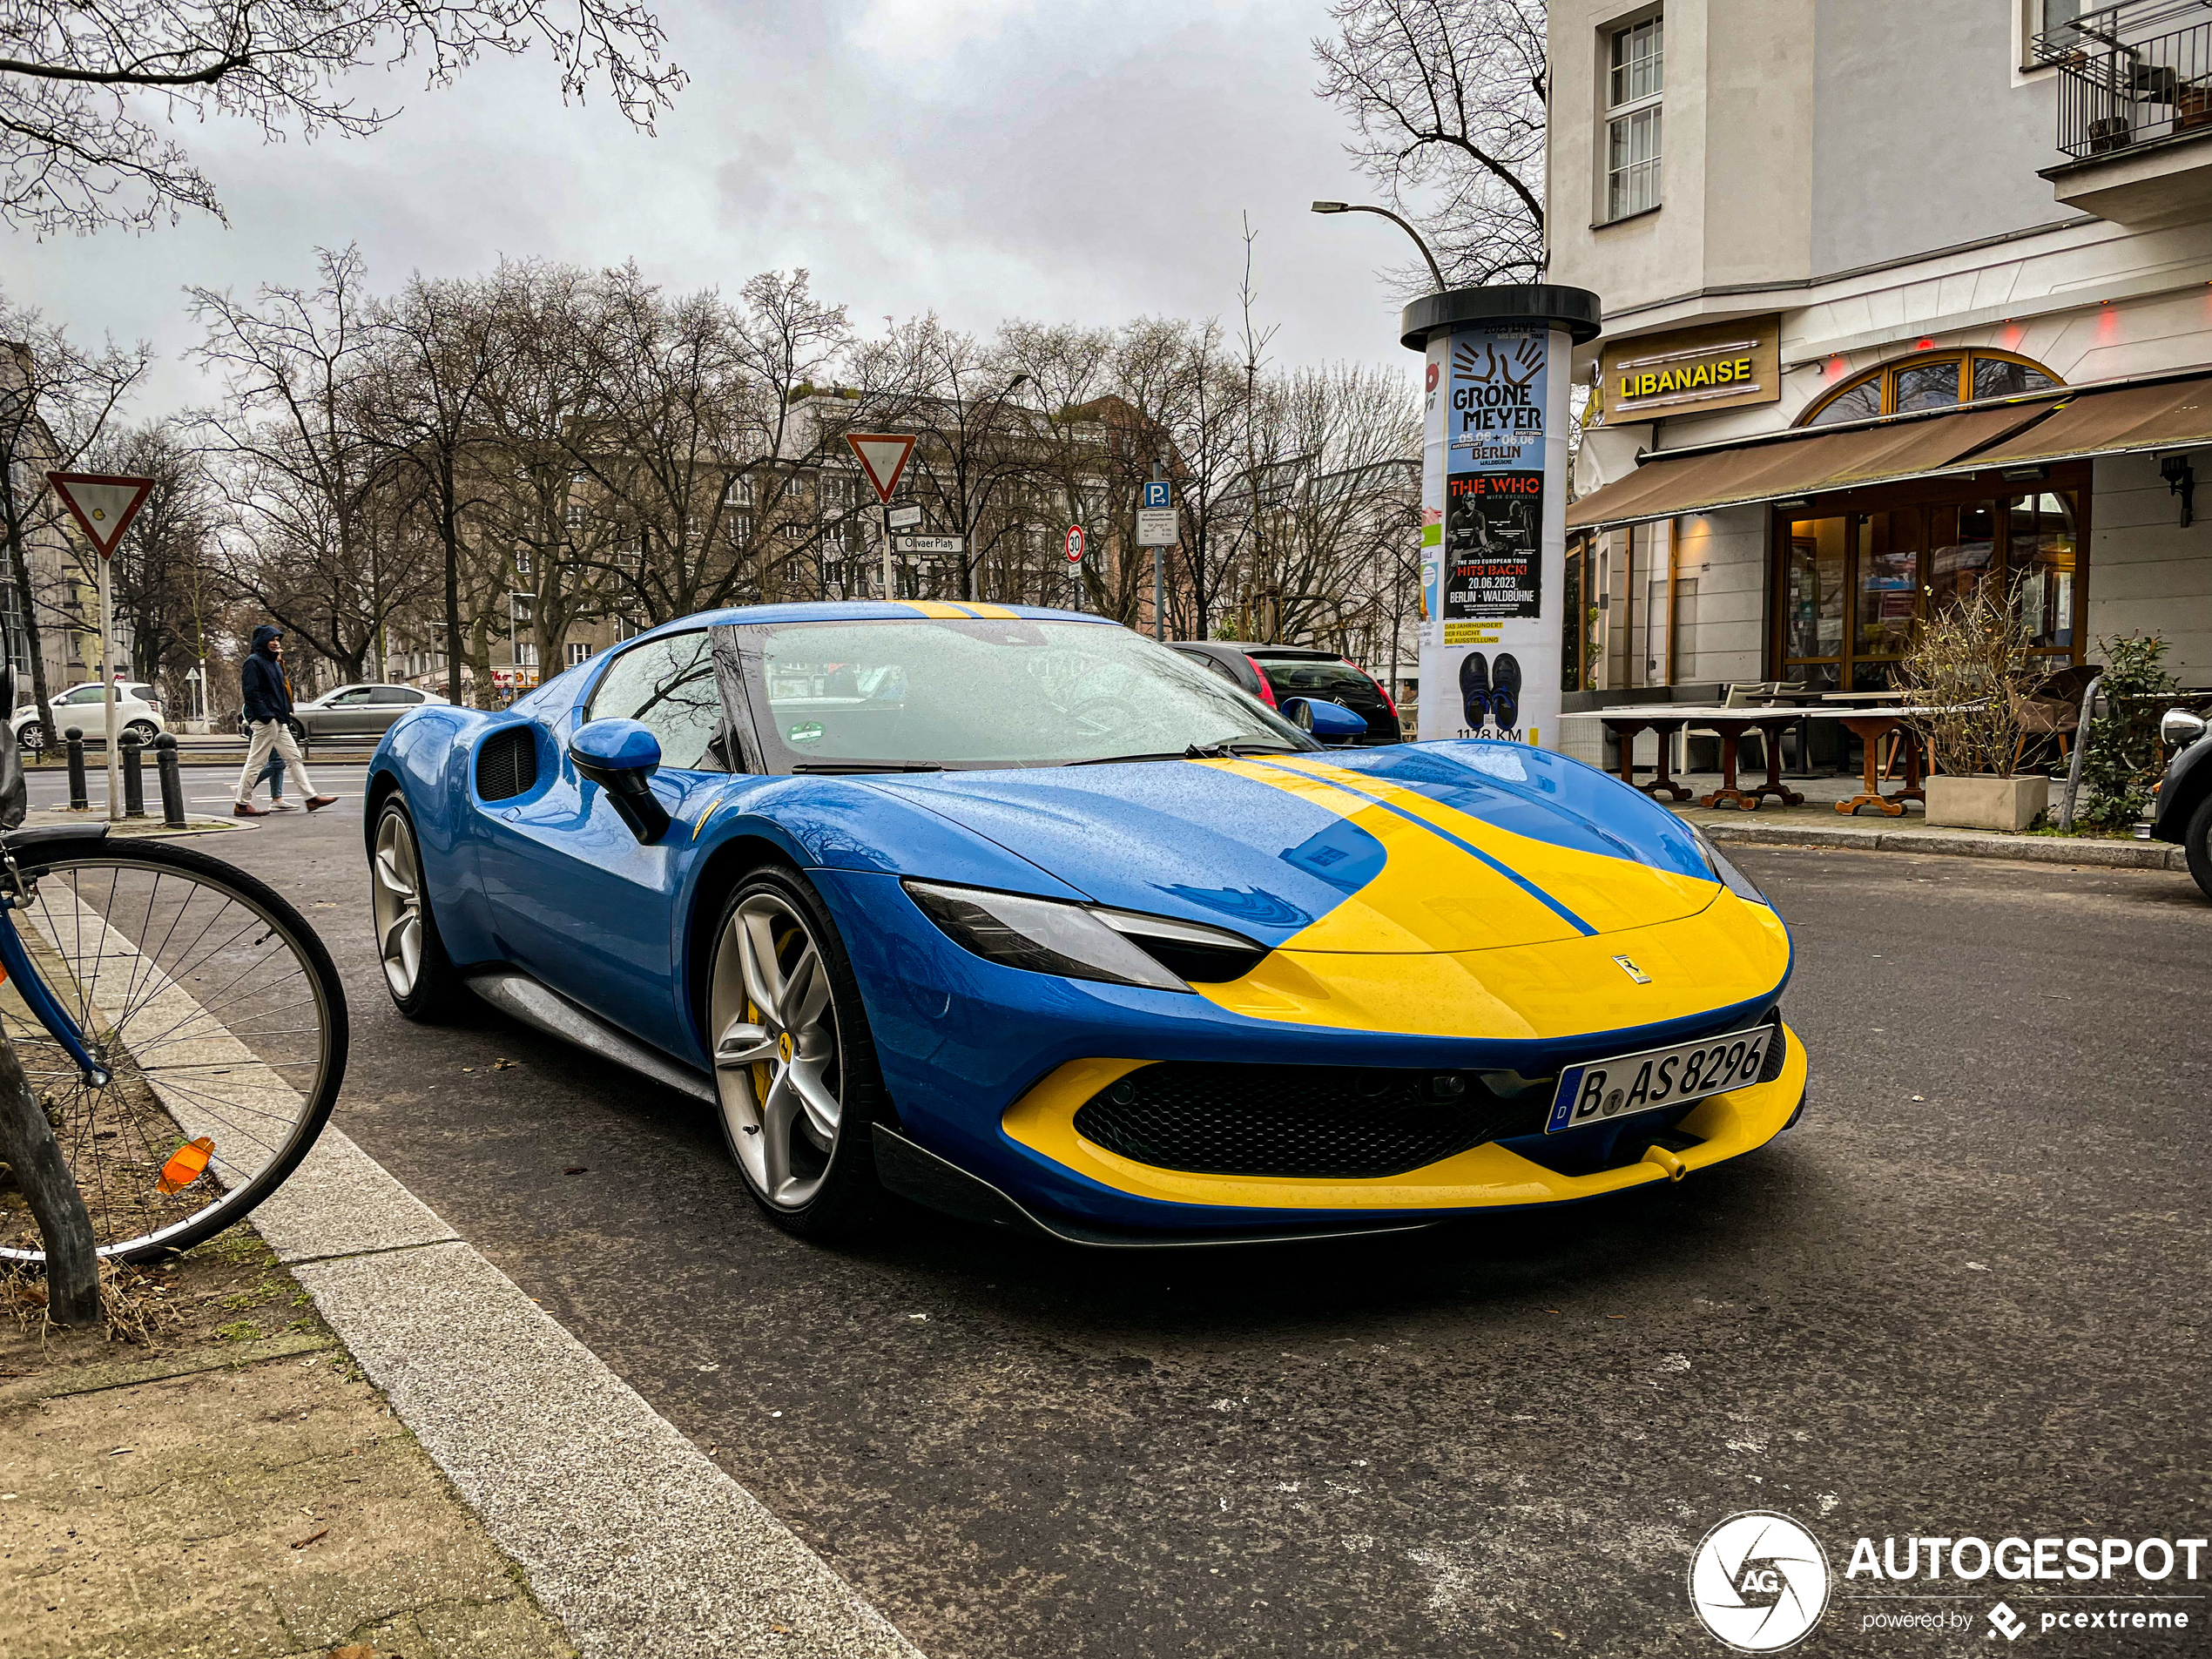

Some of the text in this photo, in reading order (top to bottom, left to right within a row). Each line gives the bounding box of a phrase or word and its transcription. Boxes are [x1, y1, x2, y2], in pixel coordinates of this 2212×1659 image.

[1484, 322, 1536, 334] 2023 LIVE
[1621, 358, 1750, 397] LIBANAISE
[1453, 380, 1532, 410] GRÖNE
[1463, 408, 1541, 431] MEYER
[1459, 431, 1491, 443] 05.06
[1501, 435, 1534, 445] 06.06
[1472, 446, 1521, 460] BERLIN
[1450, 477, 1540, 496] THE WHO
[1150, 485, 1164, 505] P
[905, 537, 954, 550] Olivaer Platz
[1069, 535, 1080, 552] 30
[1457, 564, 1527, 577] HITS BACK!
[1468, 577, 1515, 590] 20.06.2023
[1450, 590, 1476, 604] BERLIN
[1482, 588, 1534, 603] WALDBÜHNE
[1457, 729, 1492, 739] 1178
[1496, 729, 1521, 742] KM
[1575, 1035, 1764, 1118] B AS 8296
[1557, 1106, 1567, 1119] D
